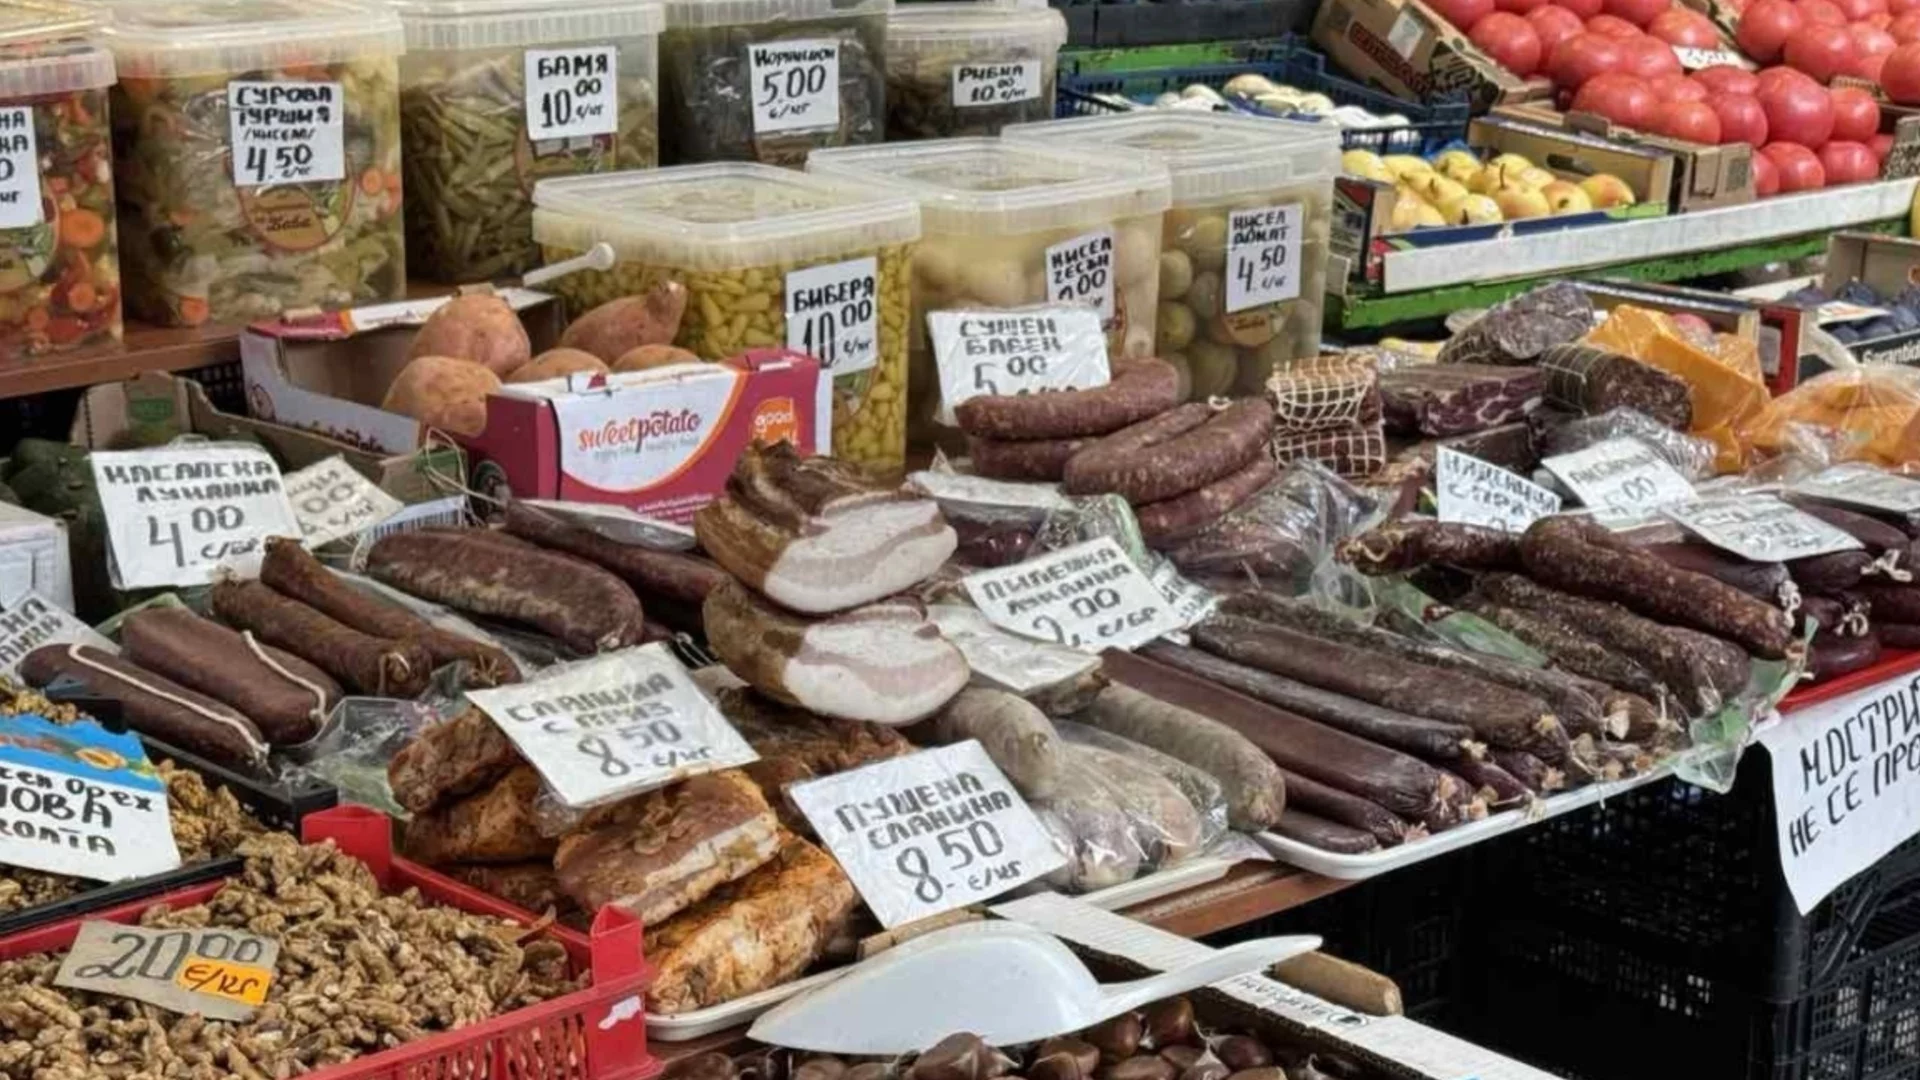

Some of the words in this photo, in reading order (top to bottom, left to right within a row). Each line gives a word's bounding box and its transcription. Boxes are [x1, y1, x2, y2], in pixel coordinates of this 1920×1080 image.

[538, 54, 608, 79] БАМЯ
[236, 86, 332, 106] СУРОВА
[793, 276, 874, 313] БИБЕРЯ
[959, 317, 1057, 338] СУШЕН
[834, 771, 984, 833] ПУШЕНА
[867, 790, 1013, 850] СЛАНИНА
[1789, 806, 1821, 857] НЕ
[1827, 770, 1862, 826] СЕ
